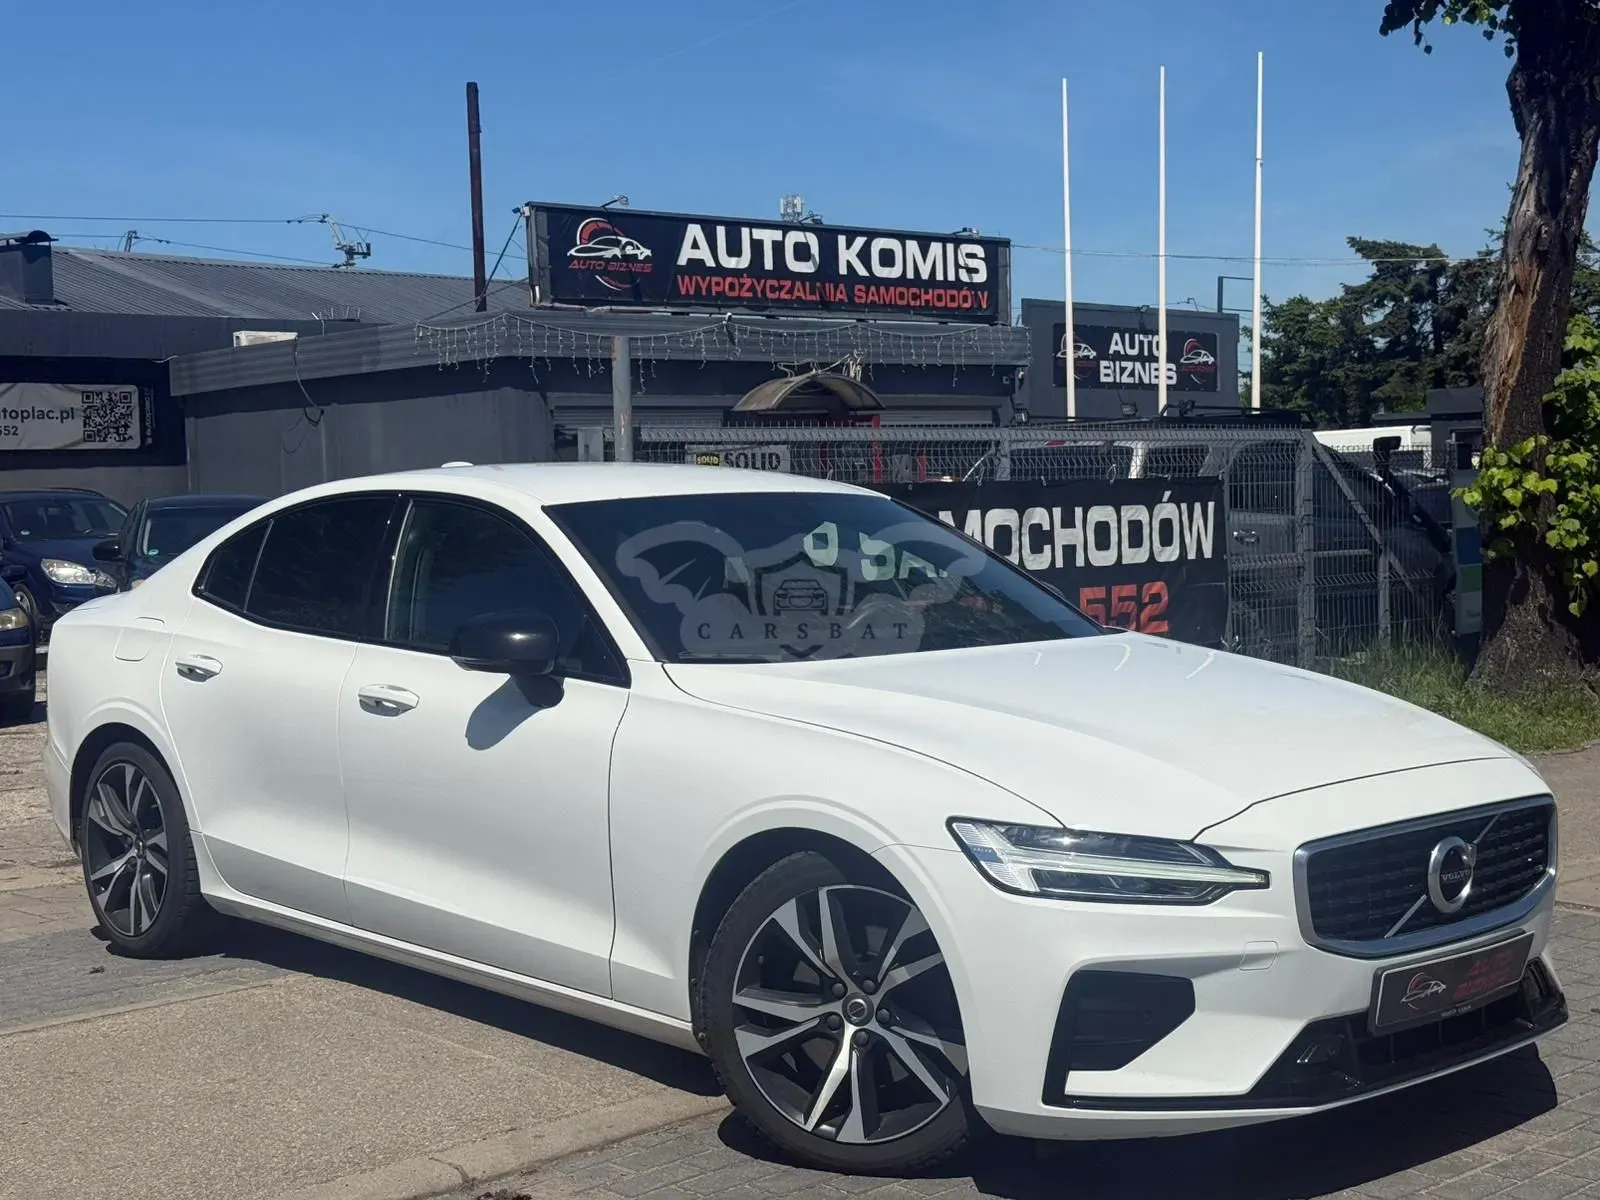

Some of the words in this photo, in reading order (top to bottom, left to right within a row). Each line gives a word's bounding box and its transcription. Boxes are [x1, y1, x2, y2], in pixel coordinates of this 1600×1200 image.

[677, 223, 819, 273] AUTO
[837, 234, 988, 283] KOMIS
[568, 259, 606, 270] AUTO
[607, 261, 653, 272] BIZNES
[677, 273, 848, 303] WYPOŻYCZALNIA
[854, 284, 988, 309] SAMOCHODÓW
[1099, 360, 1177, 385] BIZNES
[0, 425, 19, 436] 52
[724, 452, 781, 470] SOLID
[1080, 581, 1168, 633] 552
[1441, 869, 1470, 881] VOLVO
